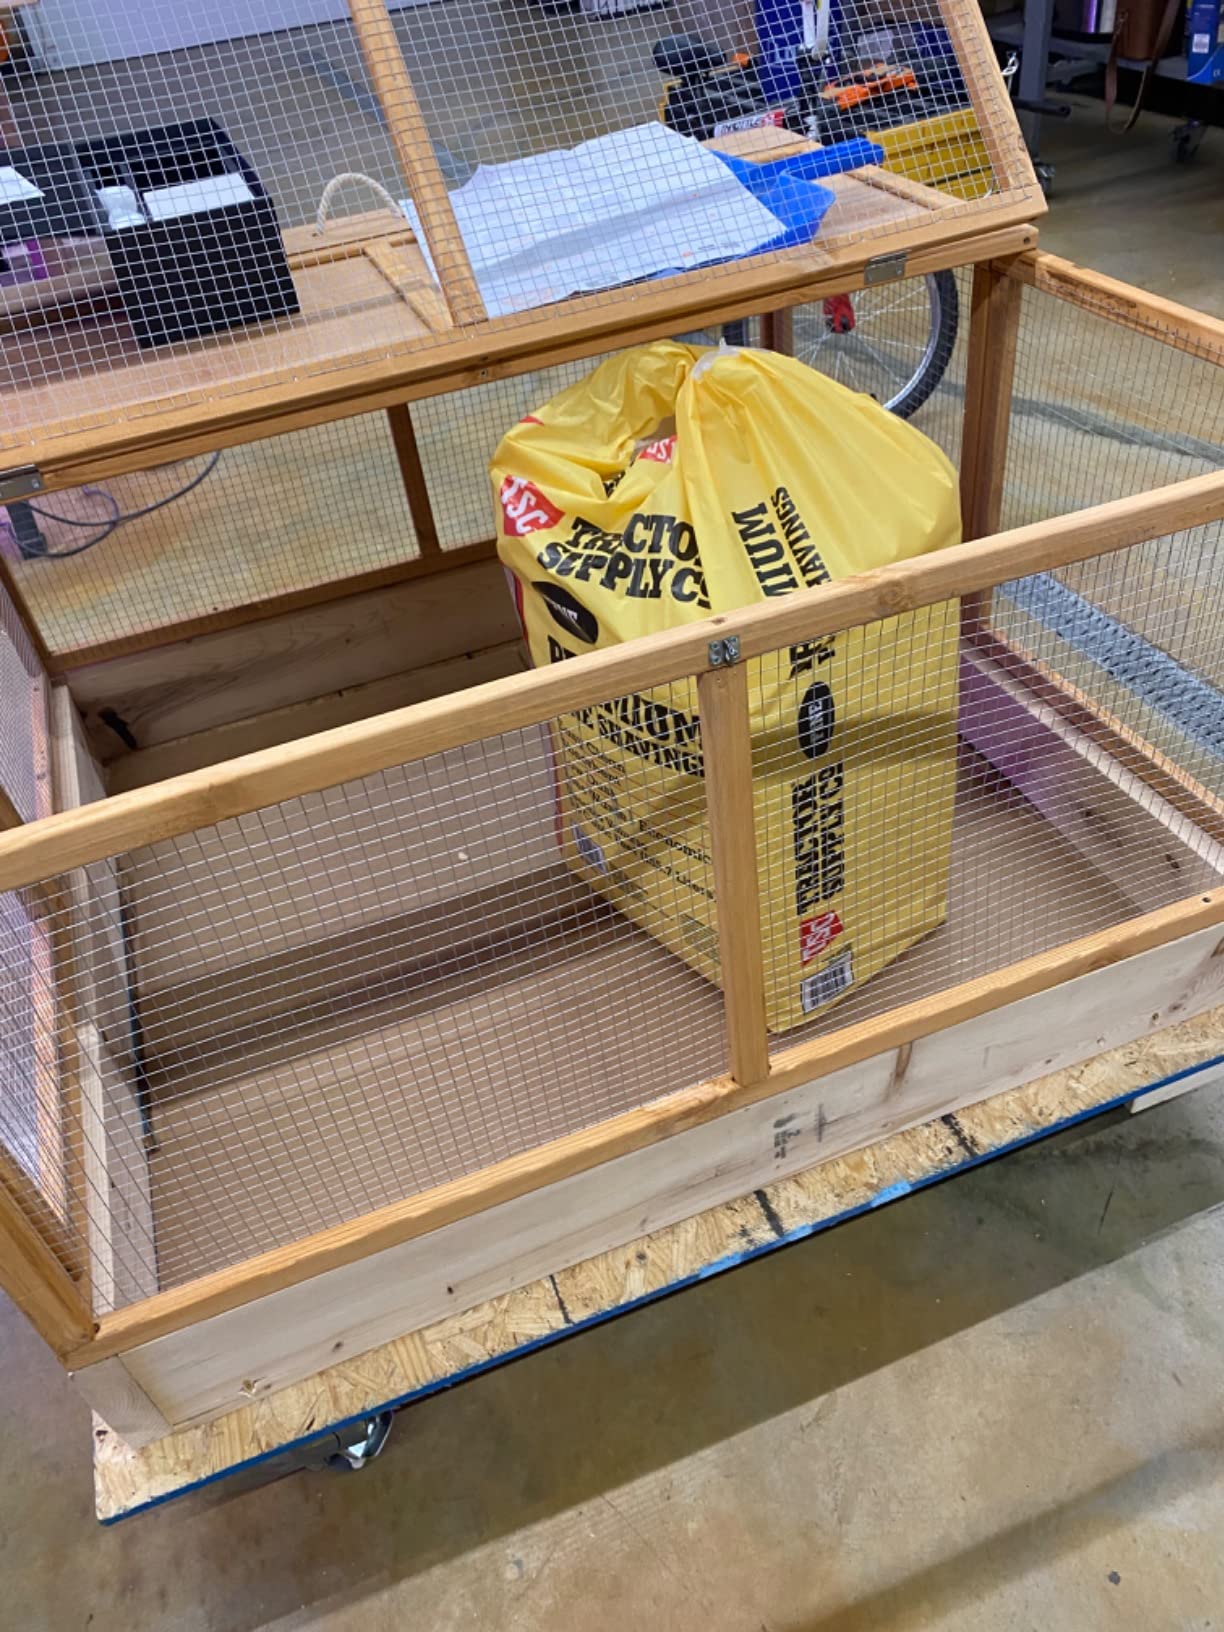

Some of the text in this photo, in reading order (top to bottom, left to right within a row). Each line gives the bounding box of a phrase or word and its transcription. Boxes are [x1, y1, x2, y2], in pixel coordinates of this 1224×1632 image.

[501, 475, 549, 535] TSC
[791, 773, 820, 916] TRACTOR
[820, 797, 845, 901] SUPPLY
[803, 911, 837, 962] TSC
